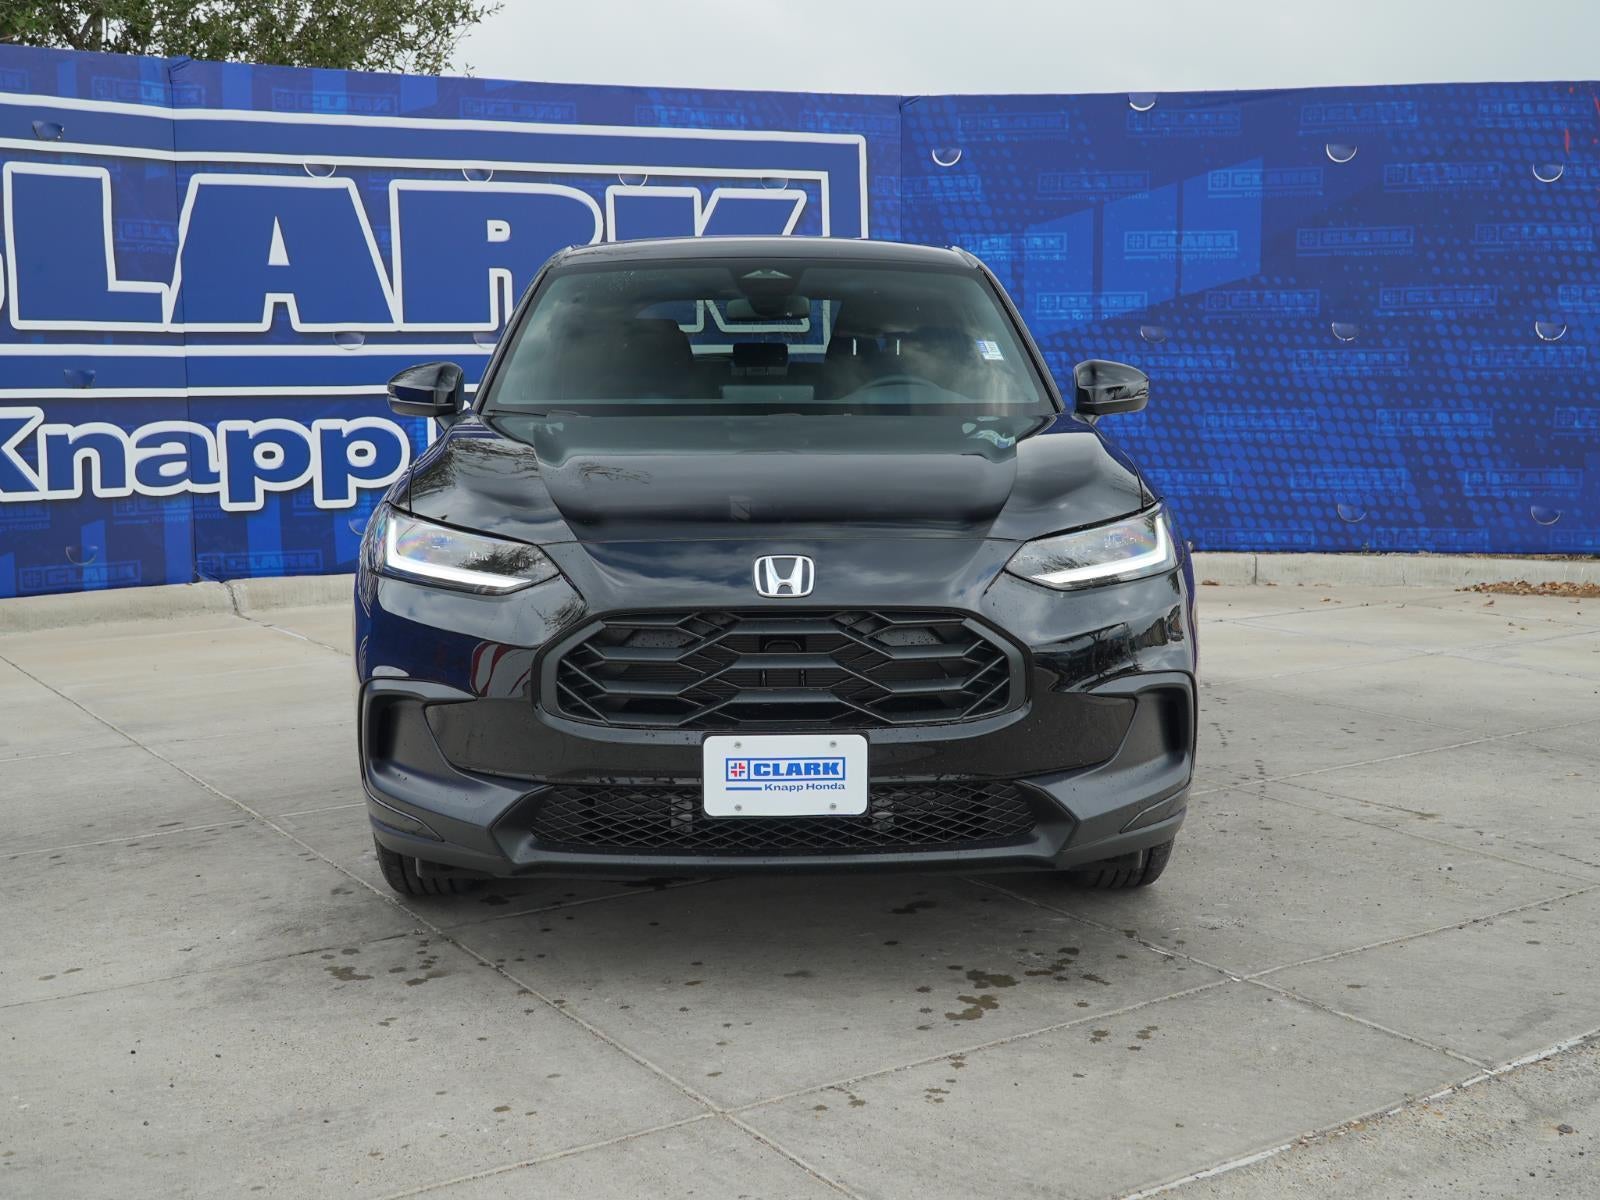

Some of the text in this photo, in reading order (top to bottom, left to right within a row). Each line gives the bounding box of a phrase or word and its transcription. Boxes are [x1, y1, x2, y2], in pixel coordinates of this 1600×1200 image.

[0, 161, 809, 334] LAR
[753, 762, 840, 777] CLARK
[764, 782, 846, 793] Knapp Honda
